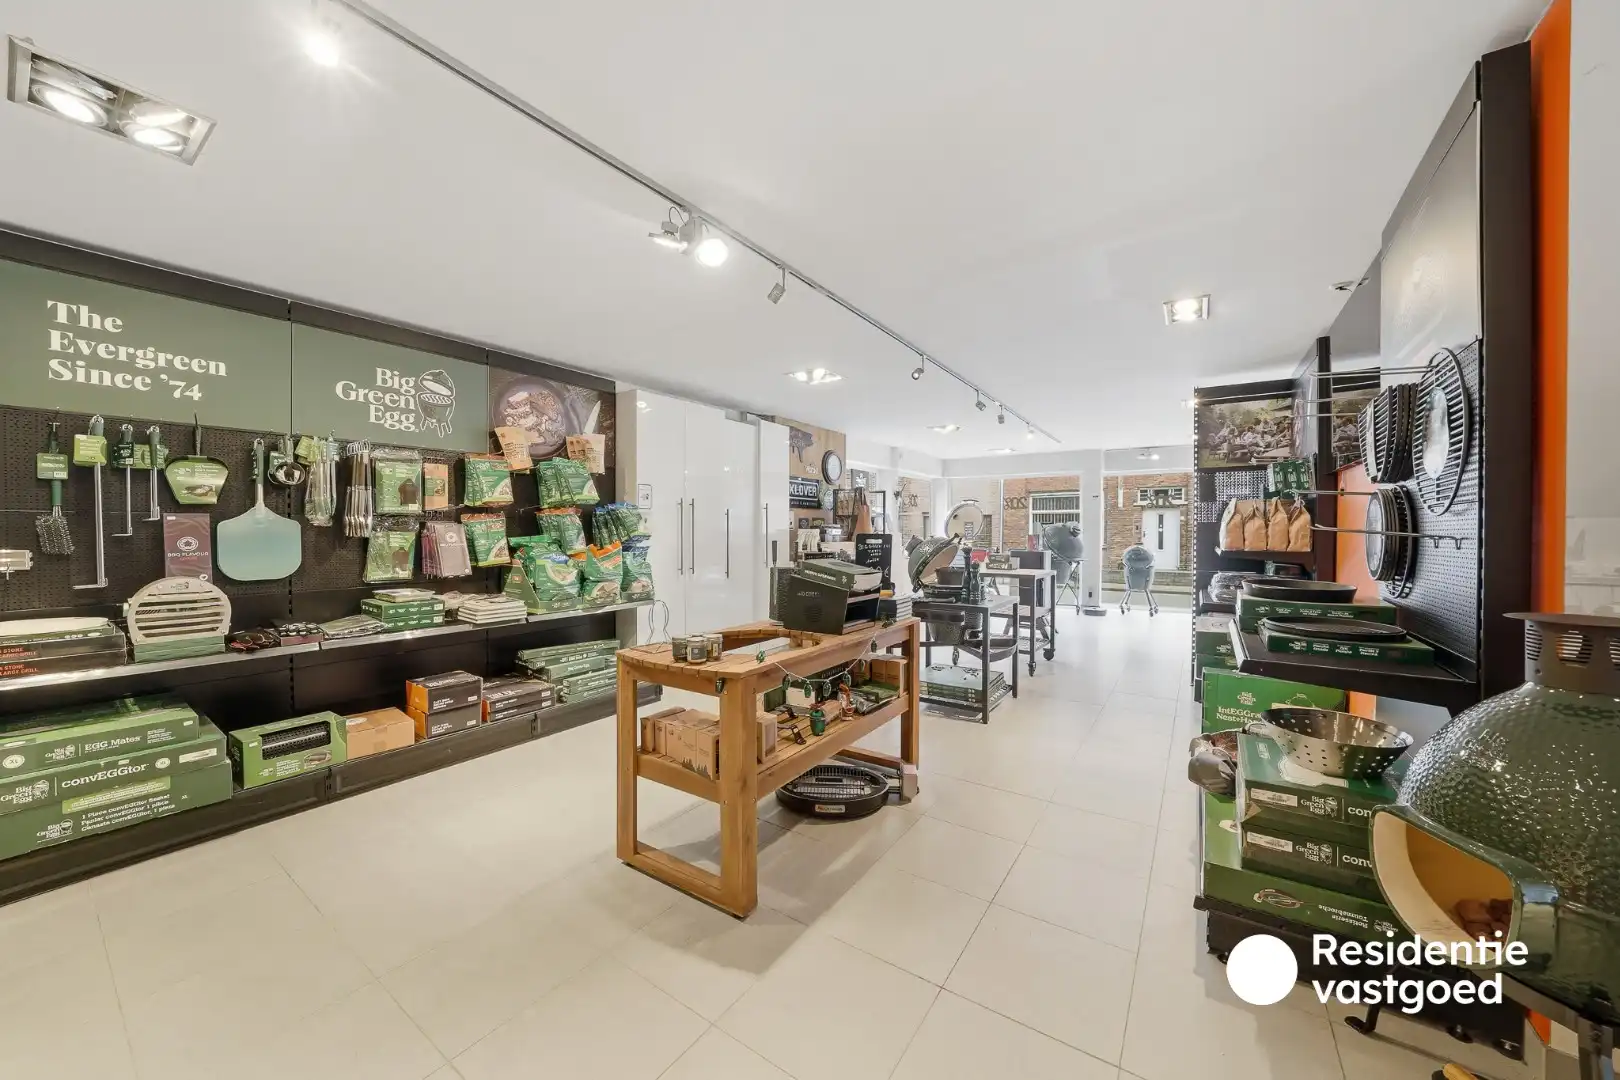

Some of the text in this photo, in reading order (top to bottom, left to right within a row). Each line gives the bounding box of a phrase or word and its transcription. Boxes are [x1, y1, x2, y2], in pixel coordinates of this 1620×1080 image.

[47, 300, 123, 333] The
[48, 329, 228, 377] Evergreen
[48, 358, 152, 391] Since
[375, 367, 416, 396] Big
[335, 380, 416, 410] Green
[84, 740, 108, 751] EGG
[111, 736, 141, 747] Mates
[61, 764, 146, 788] convEGGtor
[15, 785, 33, 794] Big
[1300, 799, 1325, 809] Green
[1311, 795, 1325, 804] Big
[1309, 805, 1325, 815] Egg
[1295, 845, 1319, 856] Green
[1306, 842, 1319, 851] Big
[1304, 852, 1319, 862] Egg
